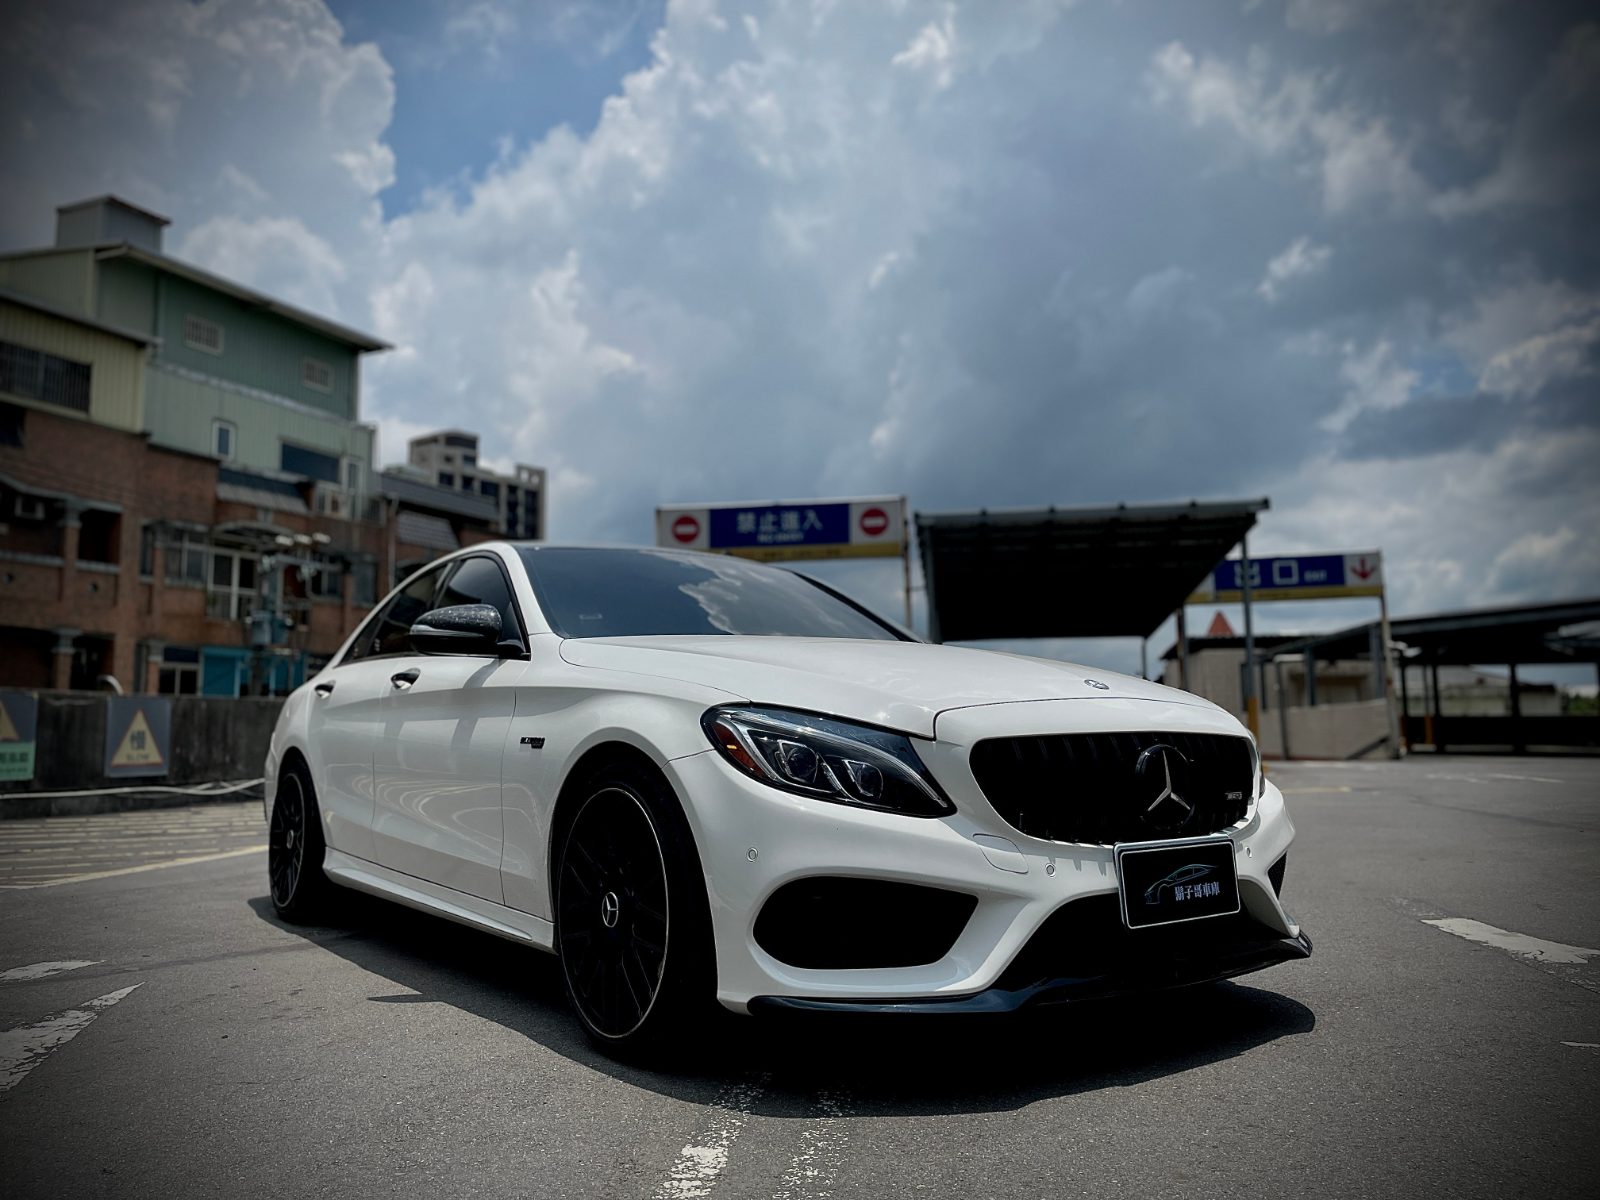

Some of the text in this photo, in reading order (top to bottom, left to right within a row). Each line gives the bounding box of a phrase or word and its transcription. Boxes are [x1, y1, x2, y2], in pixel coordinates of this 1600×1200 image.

[737, 509, 823, 533] 禁止進入
[1234, 559, 1299, 587] 出口
